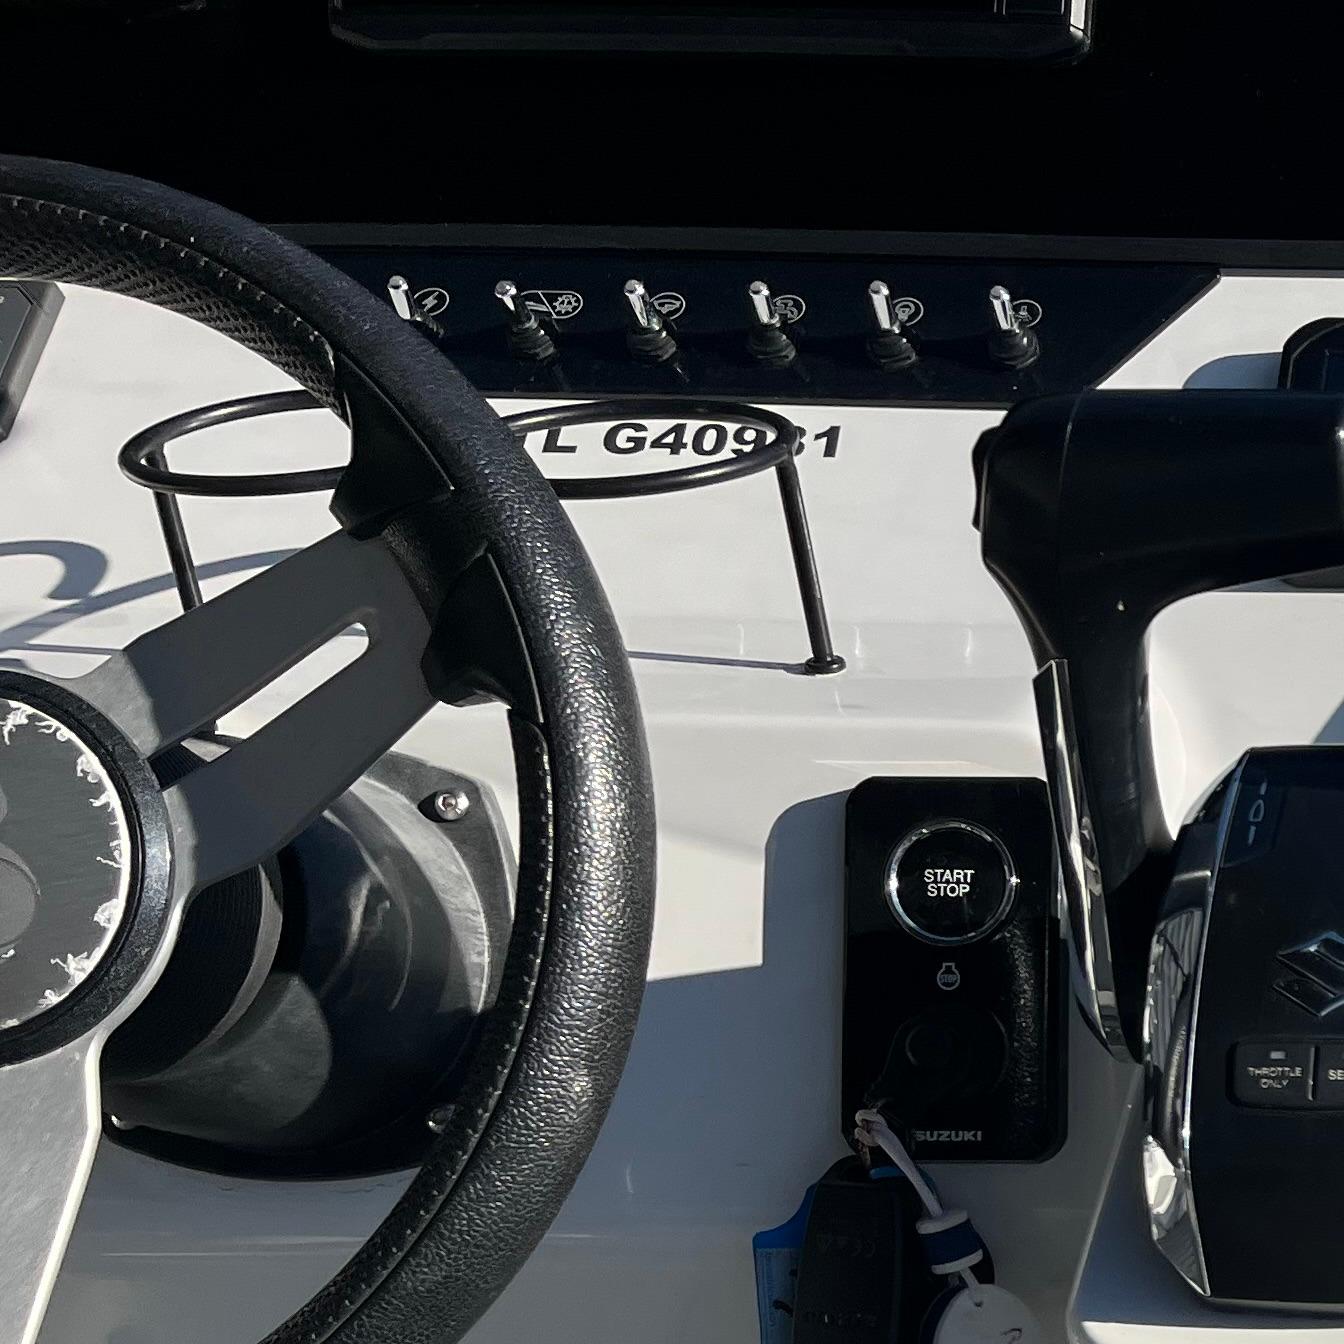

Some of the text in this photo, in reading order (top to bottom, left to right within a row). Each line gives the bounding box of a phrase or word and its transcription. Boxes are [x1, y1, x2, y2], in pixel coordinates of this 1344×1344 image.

[923, 868, 975, 883] START
[927, 884, 970, 897] STOP
[1247, 1066, 1303, 1077] THROTTLE
[1260, 1078, 1289, 1089] ONLY
[914, 1130, 982, 1142] SUZUKI
